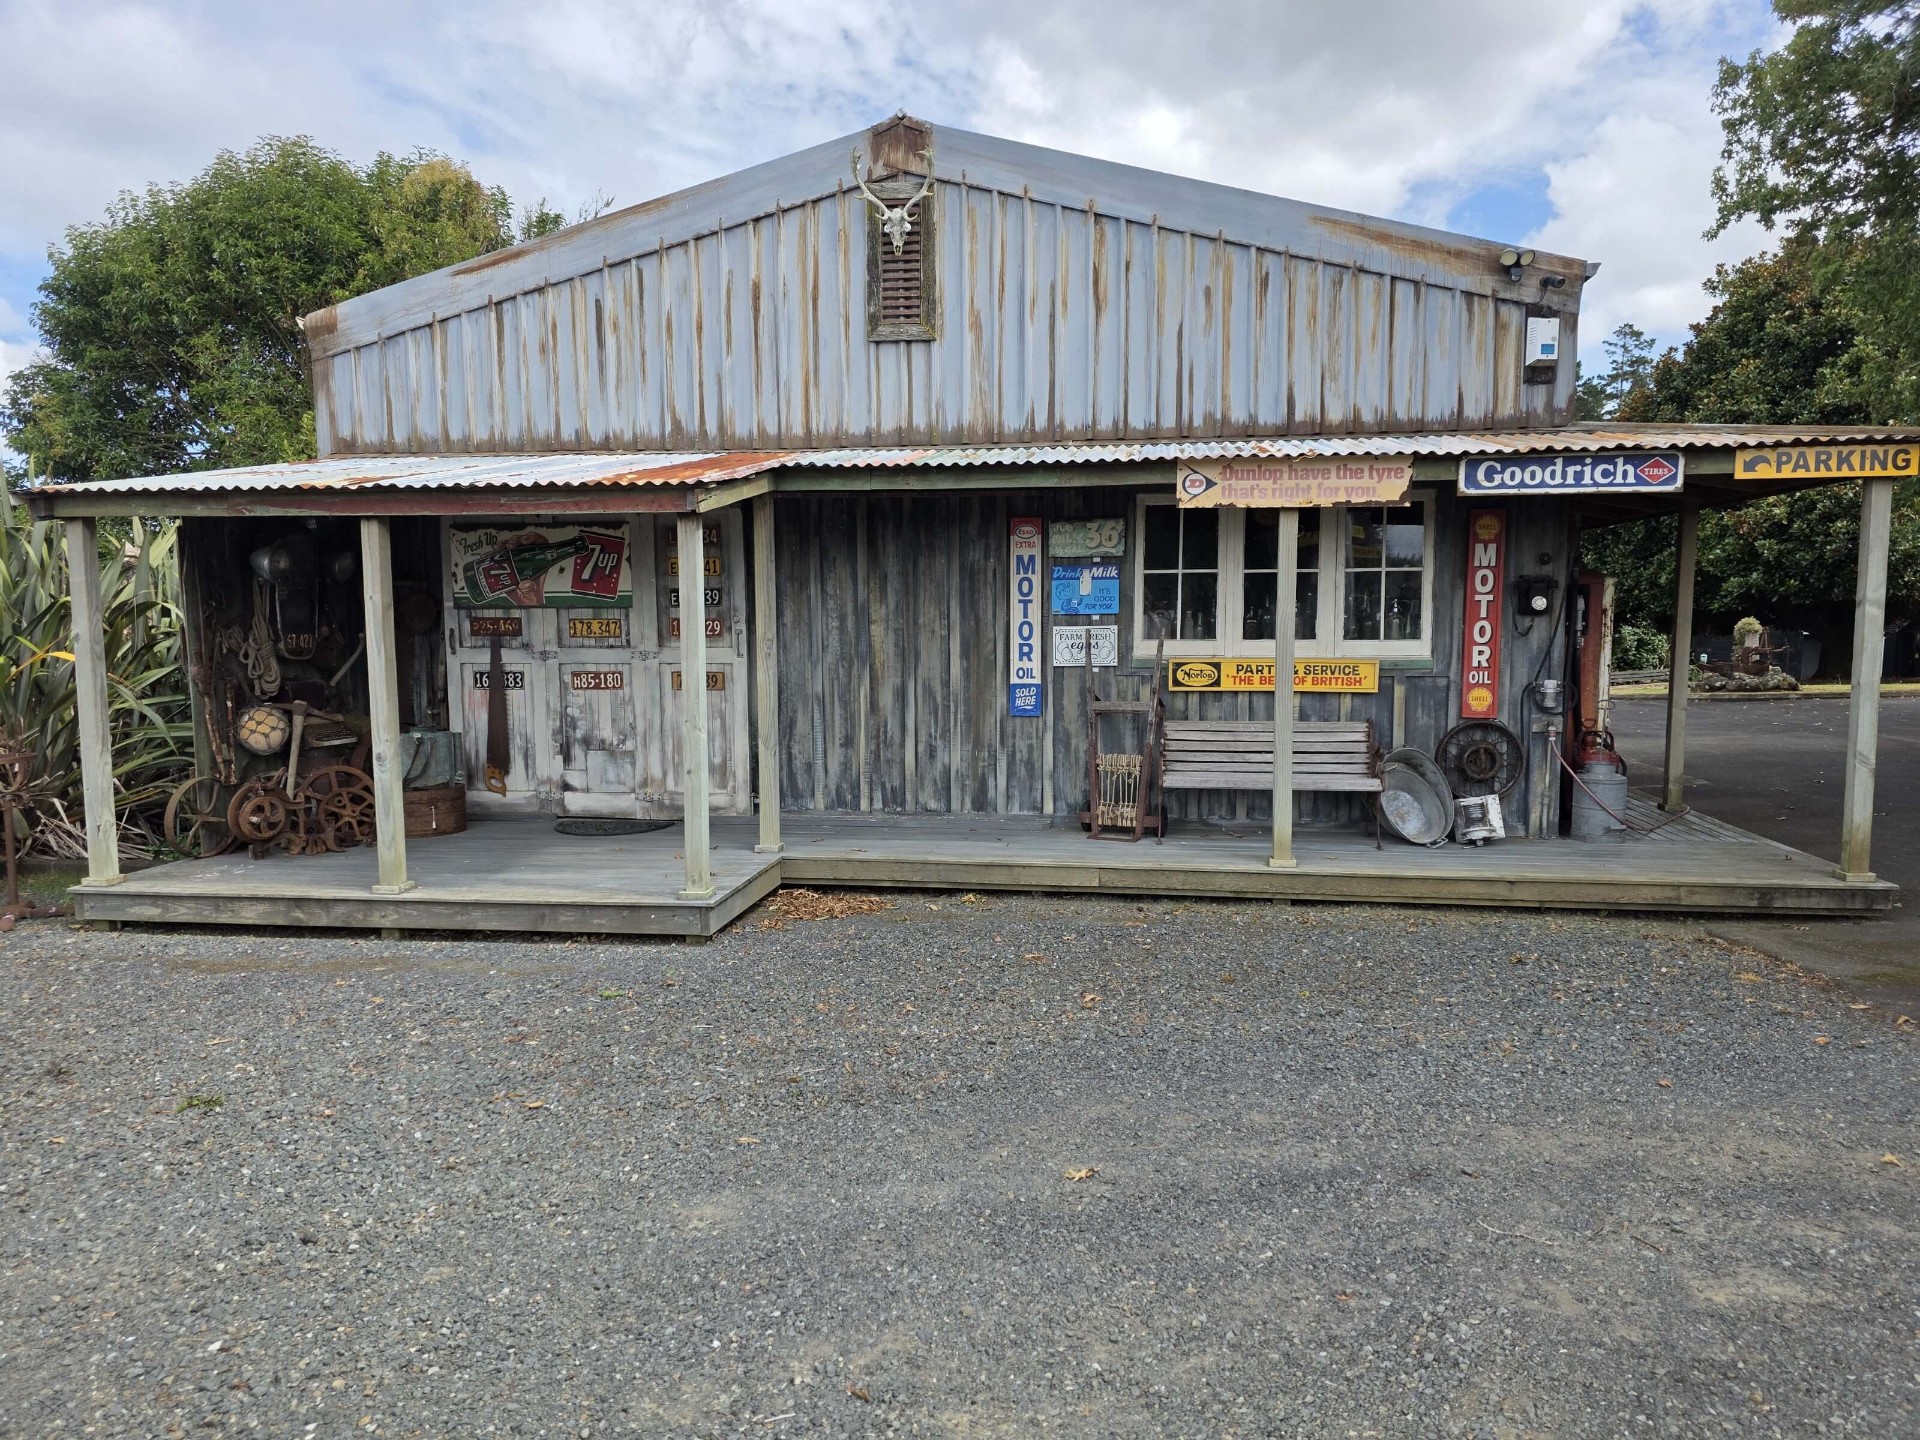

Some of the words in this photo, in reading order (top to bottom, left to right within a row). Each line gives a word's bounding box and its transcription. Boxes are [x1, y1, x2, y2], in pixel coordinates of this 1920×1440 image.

[1775, 448, 1912, 473] PARKING
[1221, 464, 1284, 485] Dunlop
[1288, 463, 1332, 481] have
[1336, 464, 1367, 481] the
[1368, 464, 1405, 484] tyre
[1476, 456, 1637, 487] Goodrich
[1643, 467, 1669, 476] TIRES
[1222, 483, 1268, 500] that's
[1271, 483, 1314, 503] right
[1316, 483, 1340, 499] for
[1017, 528, 1035, 536] Esso
[459, 535, 483, 555] Fresh
[484, 532, 498, 548] Up
[1015, 541, 1036, 549] EXTRA
[1052, 567, 1082, 579] Drink
[1090, 566, 1119, 578] Milk
[1094, 595, 1116, 603] GOOD
[1472, 543, 1497, 667] MOTOR
[1015, 554, 1036, 662] MOTOR
[1084, 603, 1098, 611] FOR
[1059, 633, 1083, 641] FARM
[1088, 633, 1111, 641] RESH
[1070, 641, 1099, 655] egs
[1015, 667, 1036, 680] OIL
[1180, 668, 1216, 681] Norton
[1236, 663, 1276, 675] PART
[1303, 664, 1360, 676] SERVICE
[1293, 675, 1308, 686] OF
[1468, 671, 1492, 684] OIL
[1015, 687, 1036, 697] SOLD
[1015, 696, 1036, 706] HERE
